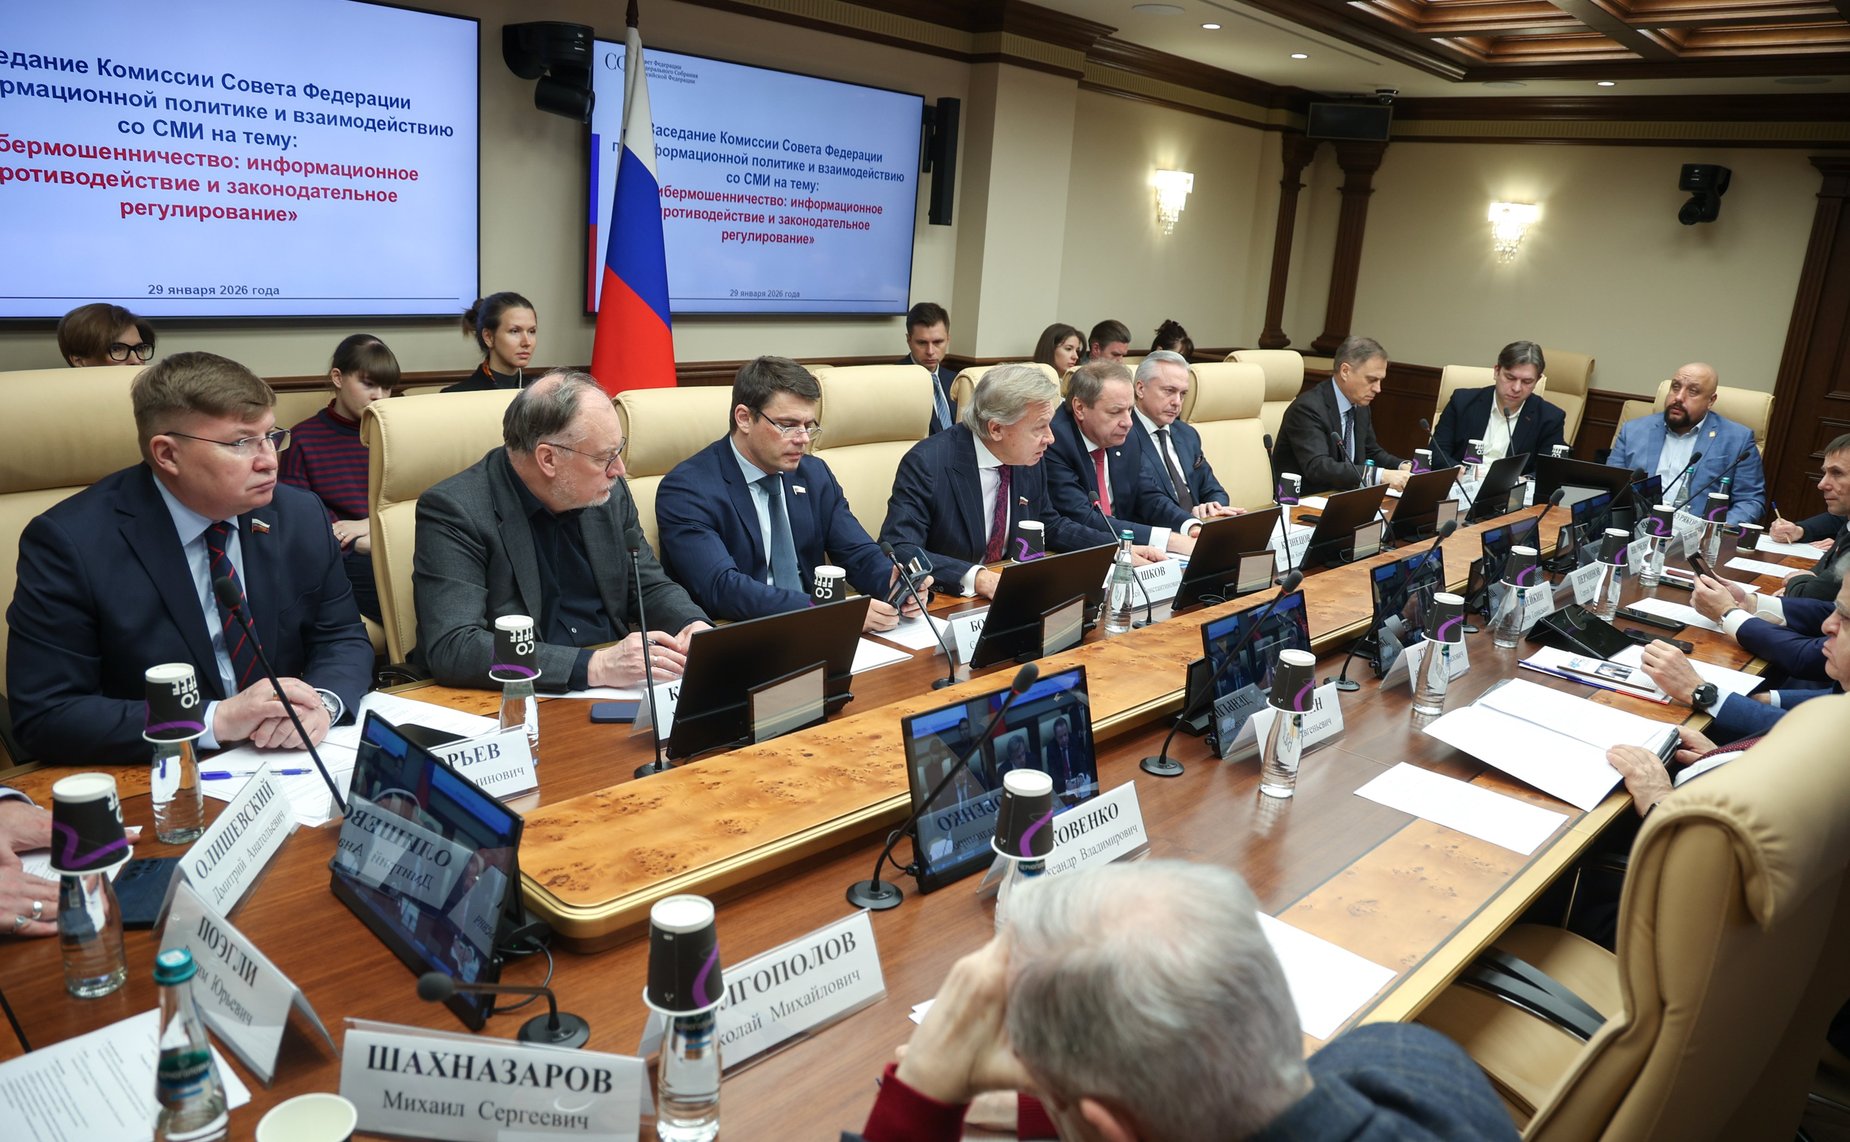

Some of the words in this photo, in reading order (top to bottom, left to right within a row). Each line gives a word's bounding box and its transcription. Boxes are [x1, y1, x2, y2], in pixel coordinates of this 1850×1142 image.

[0, 50, 89, 74] едание
[97, 57, 214, 89] Комиссии
[221, 73, 297, 98] Совета
[303, 83, 411, 110] Федерации
[0, 79, 158, 109] рмационной
[165, 97, 268, 119] политике
[275, 108, 286, 121] и
[293, 110, 454, 137] взаимодействию
[117, 120, 145, 135] со
[153, 119, 204, 140] СМИ
[212, 128, 237, 143] на
[243, 131, 298, 151] тему:
[720, 131, 779, 150] Комиссии
[782, 139, 822, 155] Совета
[825, 144, 883, 163] Федерации
[0, 133, 239, 169] бермошенничество:
[247, 156, 419, 181] информационное
[752, 156, 805, 172] политике
[808, 163, 815, 173] и
[818, 164, 905, 182] взаимодействию
[0, 166, 200, 192] ротиводействие
[207, 180, 220, 193] и
[227, 181, 398, 203] законодательное
[726, 173, 740, 184] со
[744, 172, 771, 187] СМИ
[774, 177, 787, 188] на
[790, 179, 820, 194] тему:
[120, 201, 298, 222] регулирование»
[790, 197, 883, 215] информационное
[721, 230, 815, 245] регулирование»
[768, 214, 776, 224] и
[778, 215, 871, 231] законодательное
[148, 284, 164, 295] 29
[168, 286, 216, 297] января
[220, 284, 248, 295] 2026
[252, 286, 280, 297] года
[729, 288, 739, 297] 29
[740, 290, 766, 299] января
[767, 289, 783, 298] 2026
[1280, 533, 1311, 550] КЗНЕЦОВ
[815, 586, 833, 599] CO
[515, 640, 535, 656] CO
[180, 688, 200, 709] CO
[440, 743, 501, 768] РЬЕВ
[195, 777, 275, 880] ОЛИШЕВСКИЙ
[1079, 824, 1139, 861] Владимирович
[212, 857, 247, 905] Дмитрий
[246, 810, 286, 862] Анатольевич
[197, 916, 259, 988] ПОЭГЛИ
[716, 931, 857, 1011] ЛГОПОЛОВ
[210, 973, 254, 1027] Юрьевич
[769, 969, 861, 1024] Михайлович
[366, 1044, 613, 1095] ШАХНАЗАРОВ
[382, 1089, 465, 1118] Михаил
[477, 1100, 590, 1130] Сергеевич
